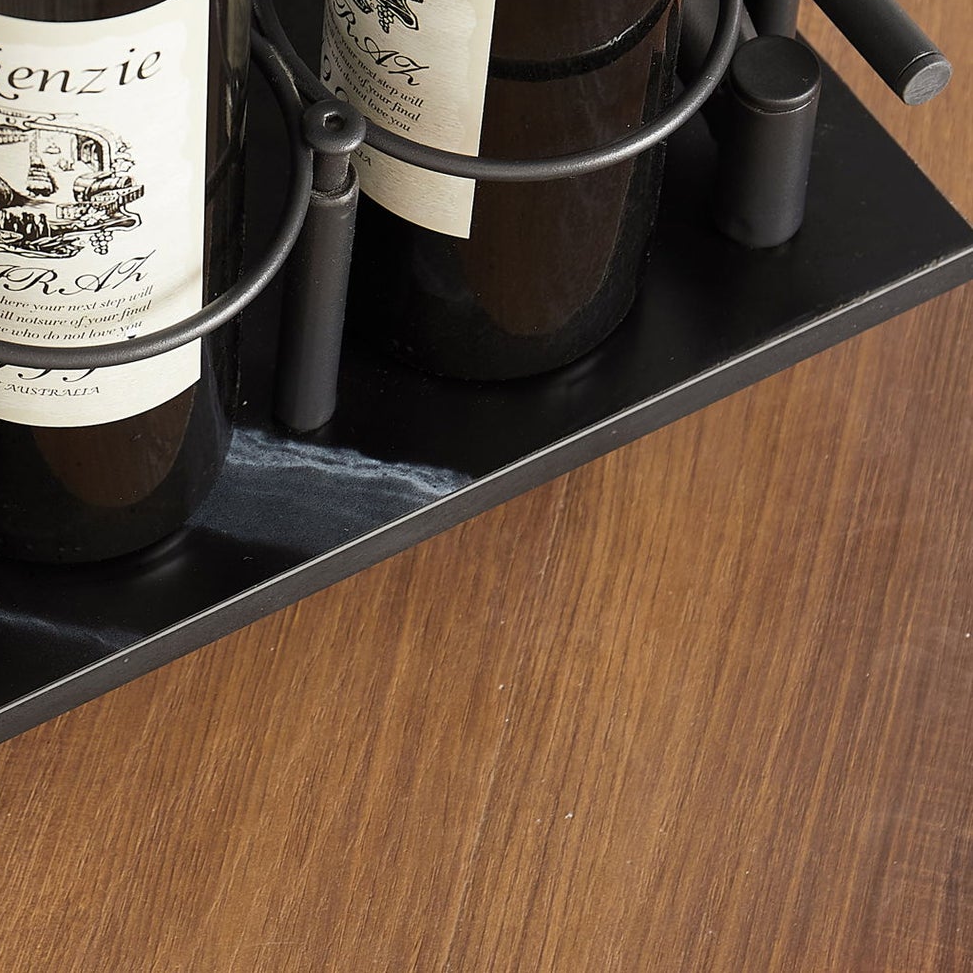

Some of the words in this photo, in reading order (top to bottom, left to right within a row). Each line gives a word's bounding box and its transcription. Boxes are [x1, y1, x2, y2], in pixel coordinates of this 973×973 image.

[357, 59, 377, 80] next
[377, 77, 399, 96] step
[400, 92, 424, 108] will
[358, 75, 370, 89] of
[366, 84, 392, 105] your
[390, 101, 421, 122] final
[353, 83, 367, 101] not
[367, 98, 389, 117] love
[387, 116, 411, 132] you
[29, 303, 66, 314] your
[67, 301, 97, 312] next
[99, 297, 126, 308] step
[128, 284, 154, 302] will
[69, 315, 87, 329] of
[84, 313, 119, 329] your
[117, 299, 152, 323] final
[11, 328, 40, 339] who
[43, 330, 60, 340] do
[63, 331, 86, 340] not
[88, 329, 117, 339] love
[115, 320, 142, 337] you
[3, 384, 101, 397] AUSTRALIA
